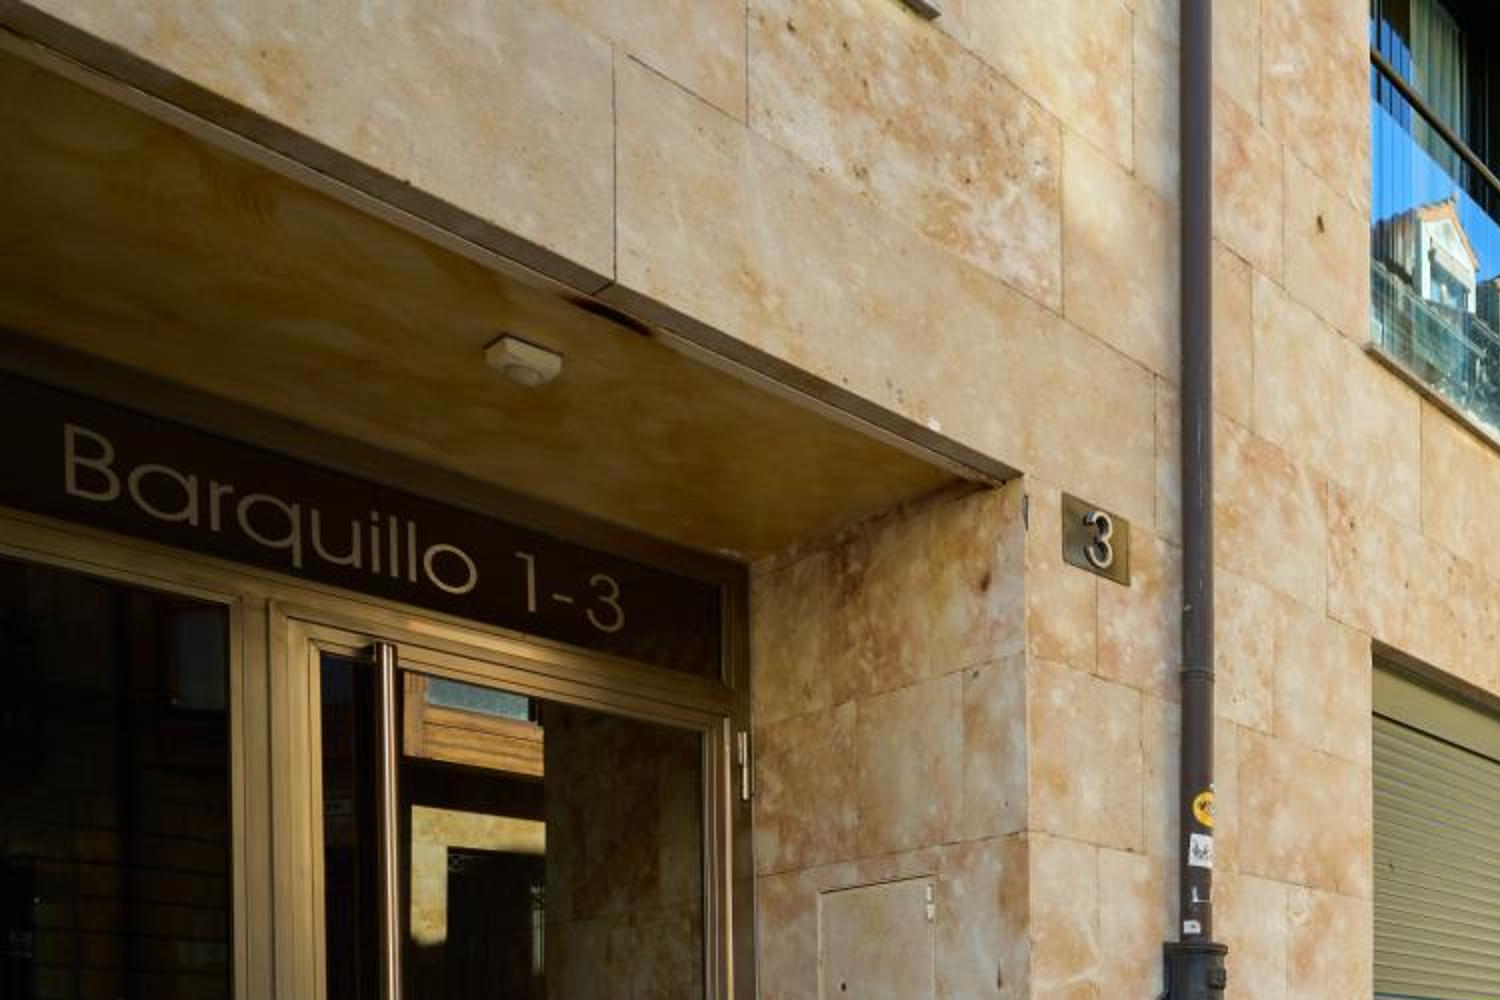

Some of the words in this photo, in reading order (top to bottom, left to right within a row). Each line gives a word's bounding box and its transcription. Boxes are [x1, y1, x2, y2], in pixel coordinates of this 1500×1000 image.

[63, 422, 479, 595] Barquillo
[514, 551, 626, 634] 1-3
[1082, 510, 1114, 569] 3
